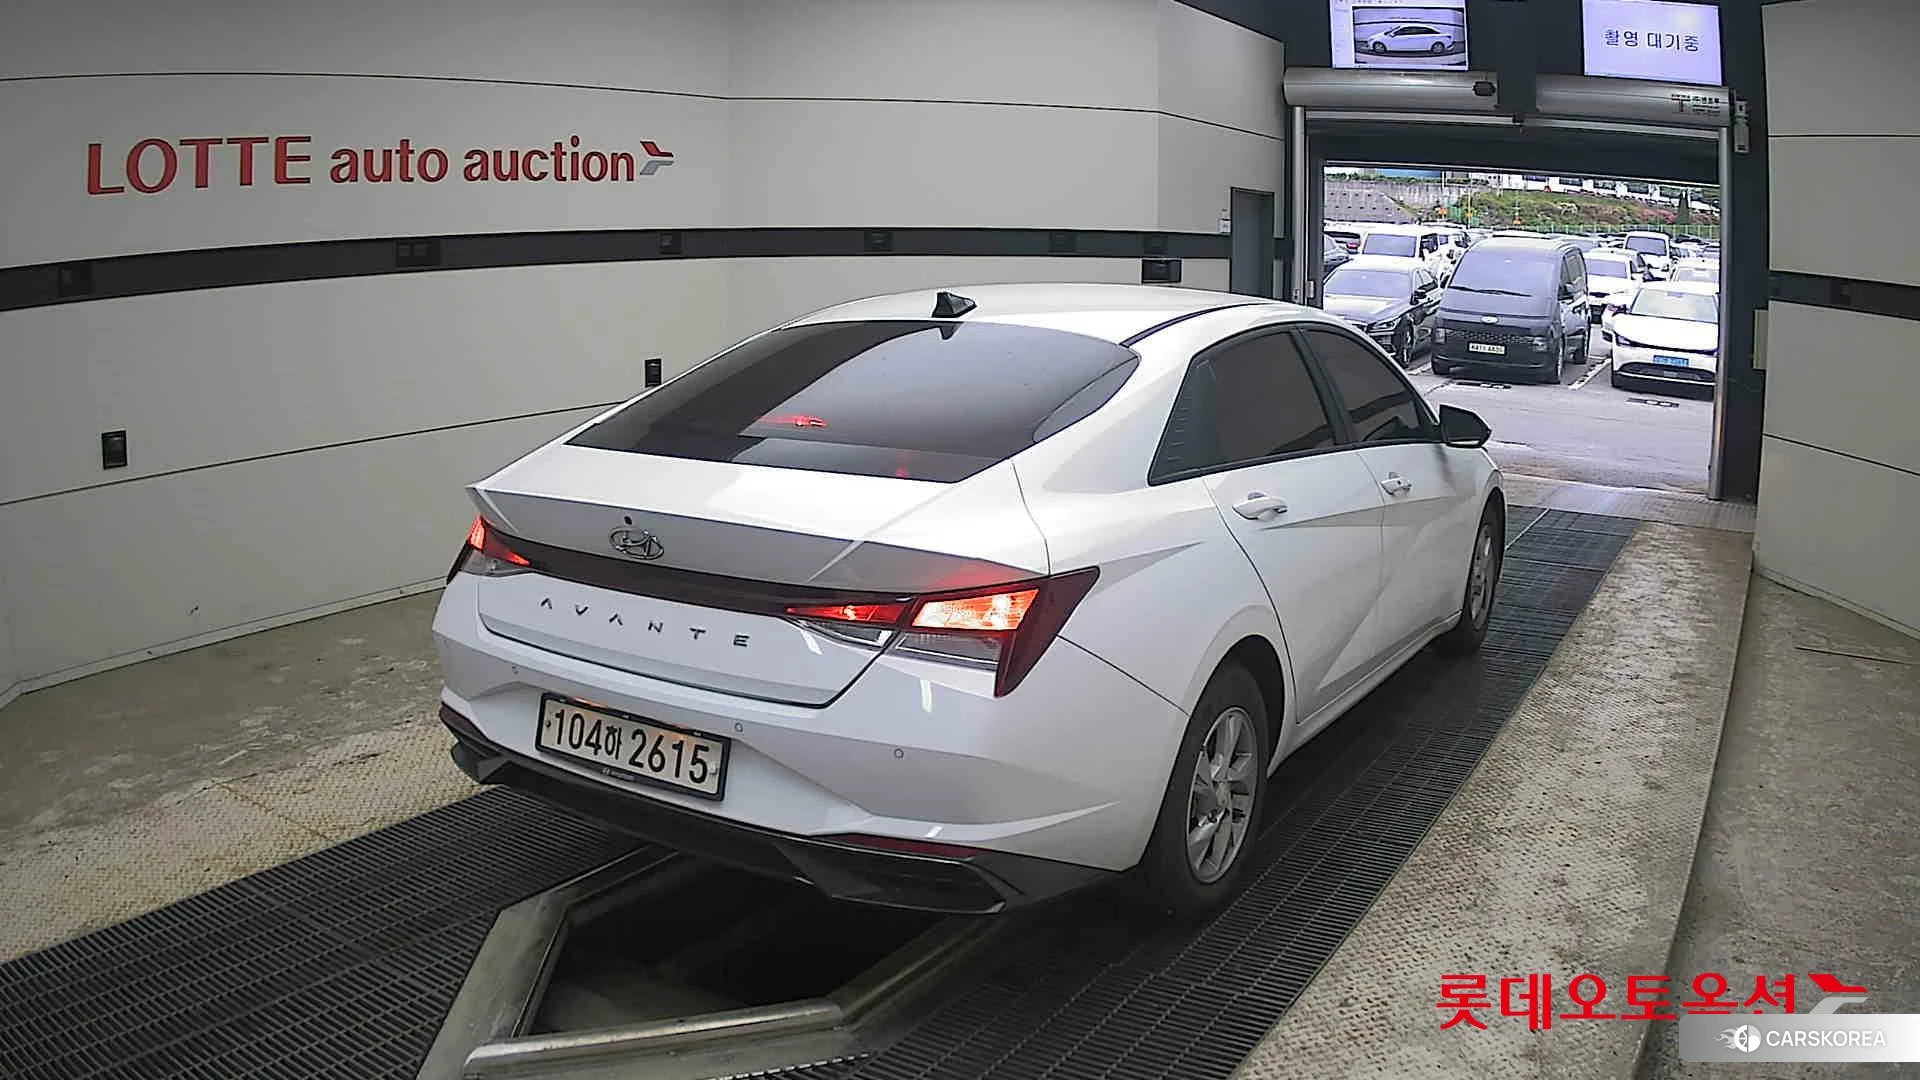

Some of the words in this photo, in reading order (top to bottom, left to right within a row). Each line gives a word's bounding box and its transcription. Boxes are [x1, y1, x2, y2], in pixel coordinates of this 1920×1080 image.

[1604, 29, 1638, 47] 촬영
[1647, 32, 1699, 52] 대기중
[87, 135, 312, 195] LOTTE
[329, 138, 449, 184] auto
[463, 135, 635, 183] auction
[540, 597, 750, 648] AVANTE
